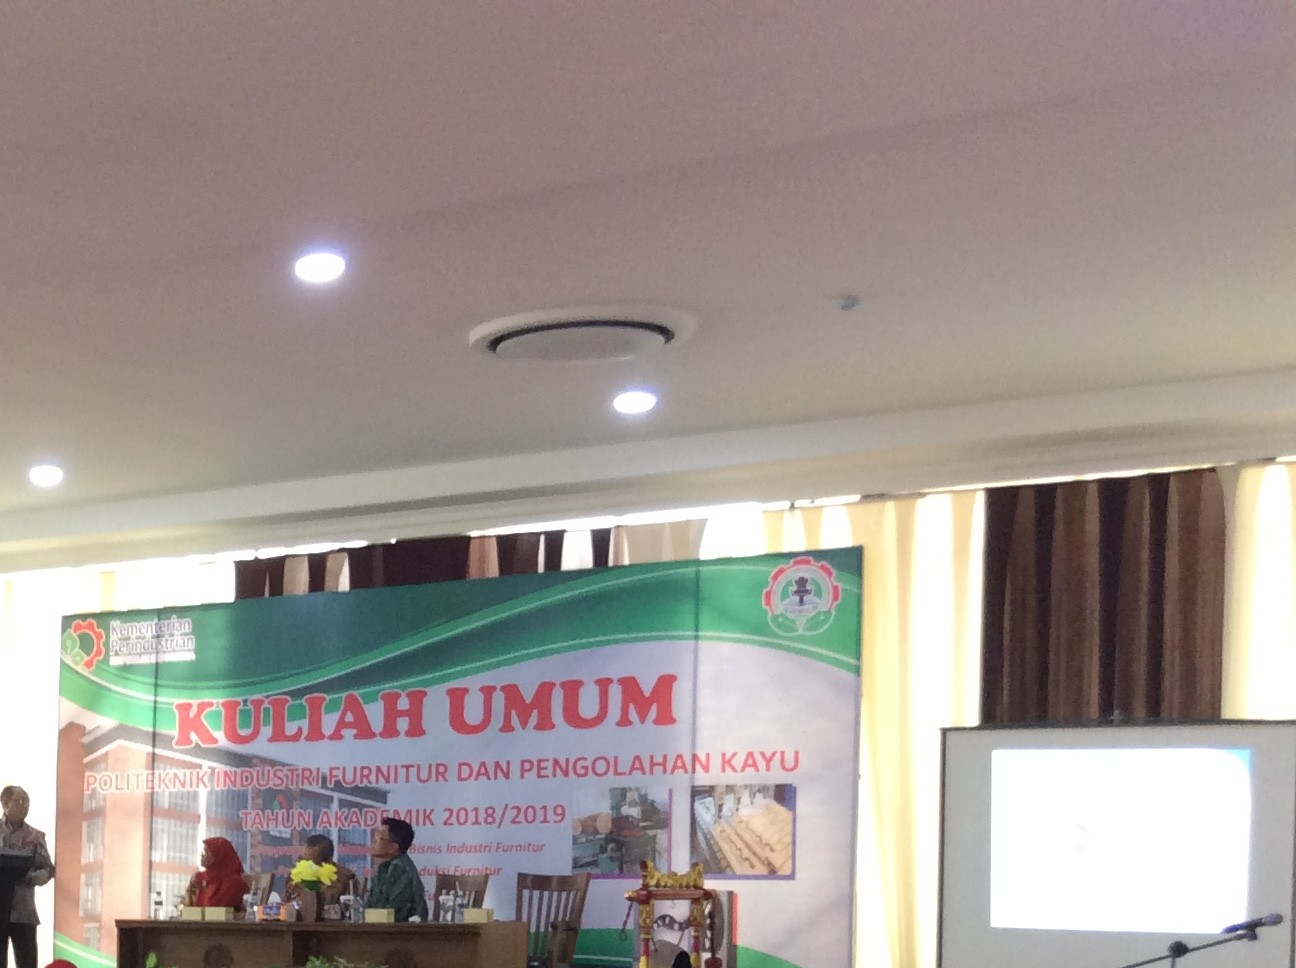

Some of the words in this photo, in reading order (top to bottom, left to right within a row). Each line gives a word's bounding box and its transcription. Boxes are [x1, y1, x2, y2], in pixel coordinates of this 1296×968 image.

[110, 615, 192, 637] Kementerian
[110, 634, 195, 656] Perindustrian
[173, 688, 429, 749] KULIAH
[446, 673, 678, 736] UMUM
[84, 770, 209, 793] POLITEKNIK
[214, 766, 321, 790] INDUSTRI
[327, 762, 449, 787] FURNITUR
[456, 759, 512, 782] DAN
[518, 752, 712, 780] PENGOLAHAN
[720, 749, 801, 774] KAYU
[240, 809, 313, 830] TAHUN
[442, 803, 567, 828] 2018/2019
[446, 841, 493, 854] Industri
[495, 841, 546, 853] Furnitur
